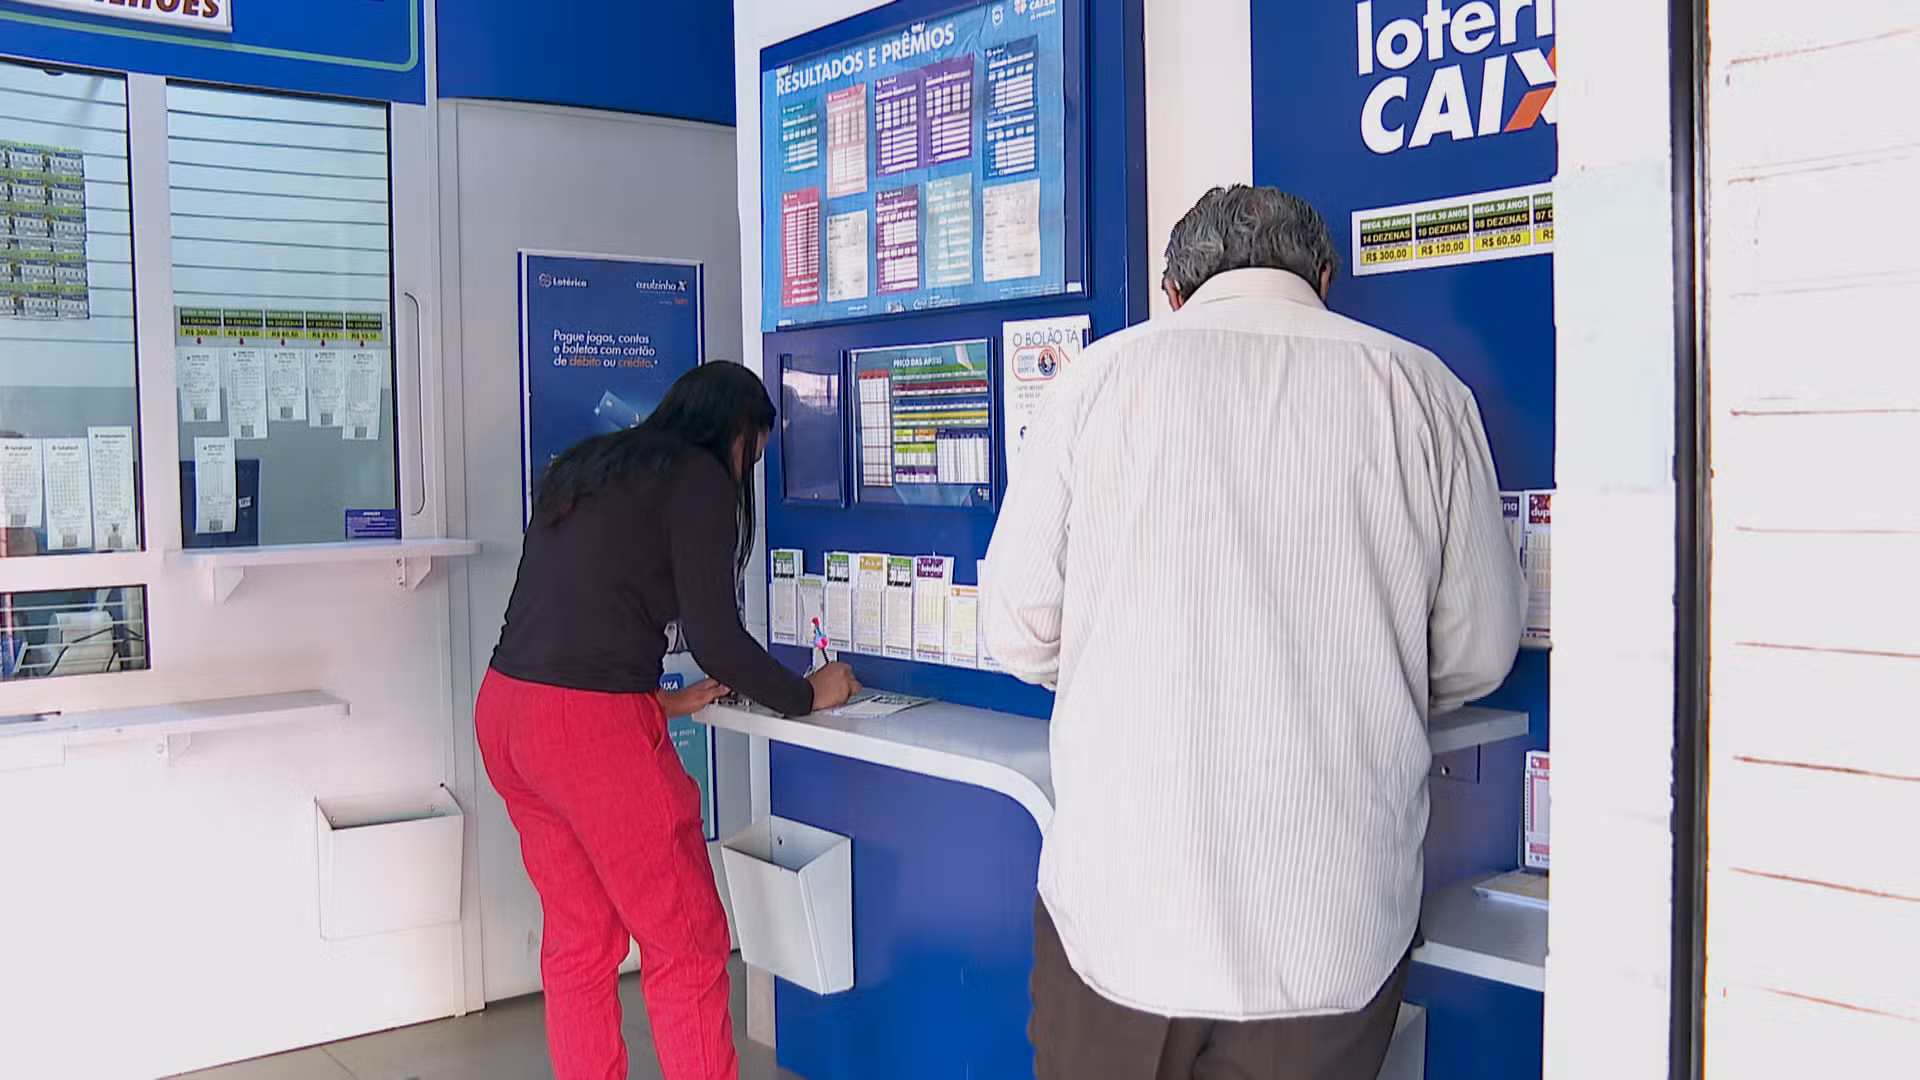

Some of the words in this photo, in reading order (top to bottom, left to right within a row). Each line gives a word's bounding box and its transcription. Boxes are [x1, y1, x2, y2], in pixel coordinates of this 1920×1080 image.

[776, 50, 865, 97] RESULTADOS
[868, 47, 877, 69] E
[881, 22, 955, 65] PRÊMIOS
[1474, 206, 1496, 215] MEGA
[1506, 199, 1528, 211] ANOS
[1391, 216, 1411, 227] ANOS
[1416, 213, 1437, 222] MEGA
[1448, 207, 1468, 218] ANOS
[1486, 213, 1528, 227] DEZENAS
[1536, 211, 1546, 220] 07
[1418, 228, 1427, 237] 10
[1428, 222, 1468, 236] DEZENAS
[1363, 235, 1371, 244] 14
[1373, 230, 1411, 242] DEZENAS
[1482, 237, 1494, 248] R$
[1497, 233, 1521, 246] 60,50
[1365, 252, 1377, 262] R$
[1379, 248, 1407, 260] 300,00
[1421, 245, 1433, 256] R$
[1436, 241, 1464, 254] 120,00
[553, 276, 588, 288] Lotérica
[636, 279, 677, 291] azulzinha
[553, 329, 585, 345] Pague
[586, 331, 616, 346] jogos,
[618, 333, 650, 345] contas
[1013, 332, 1022, 347] O
[1025, 327, 1063, 346] BOLÃO
[553, 344, 560, 354] e
[562, 342, 598, 355] boletos
[600, 346, 622, 355] com
[623, 345, 656, 356] cartão
[553, 354, 567, 367] de
[569, 355, 601, 368] débito
[603, 358, 616, 367] ou
